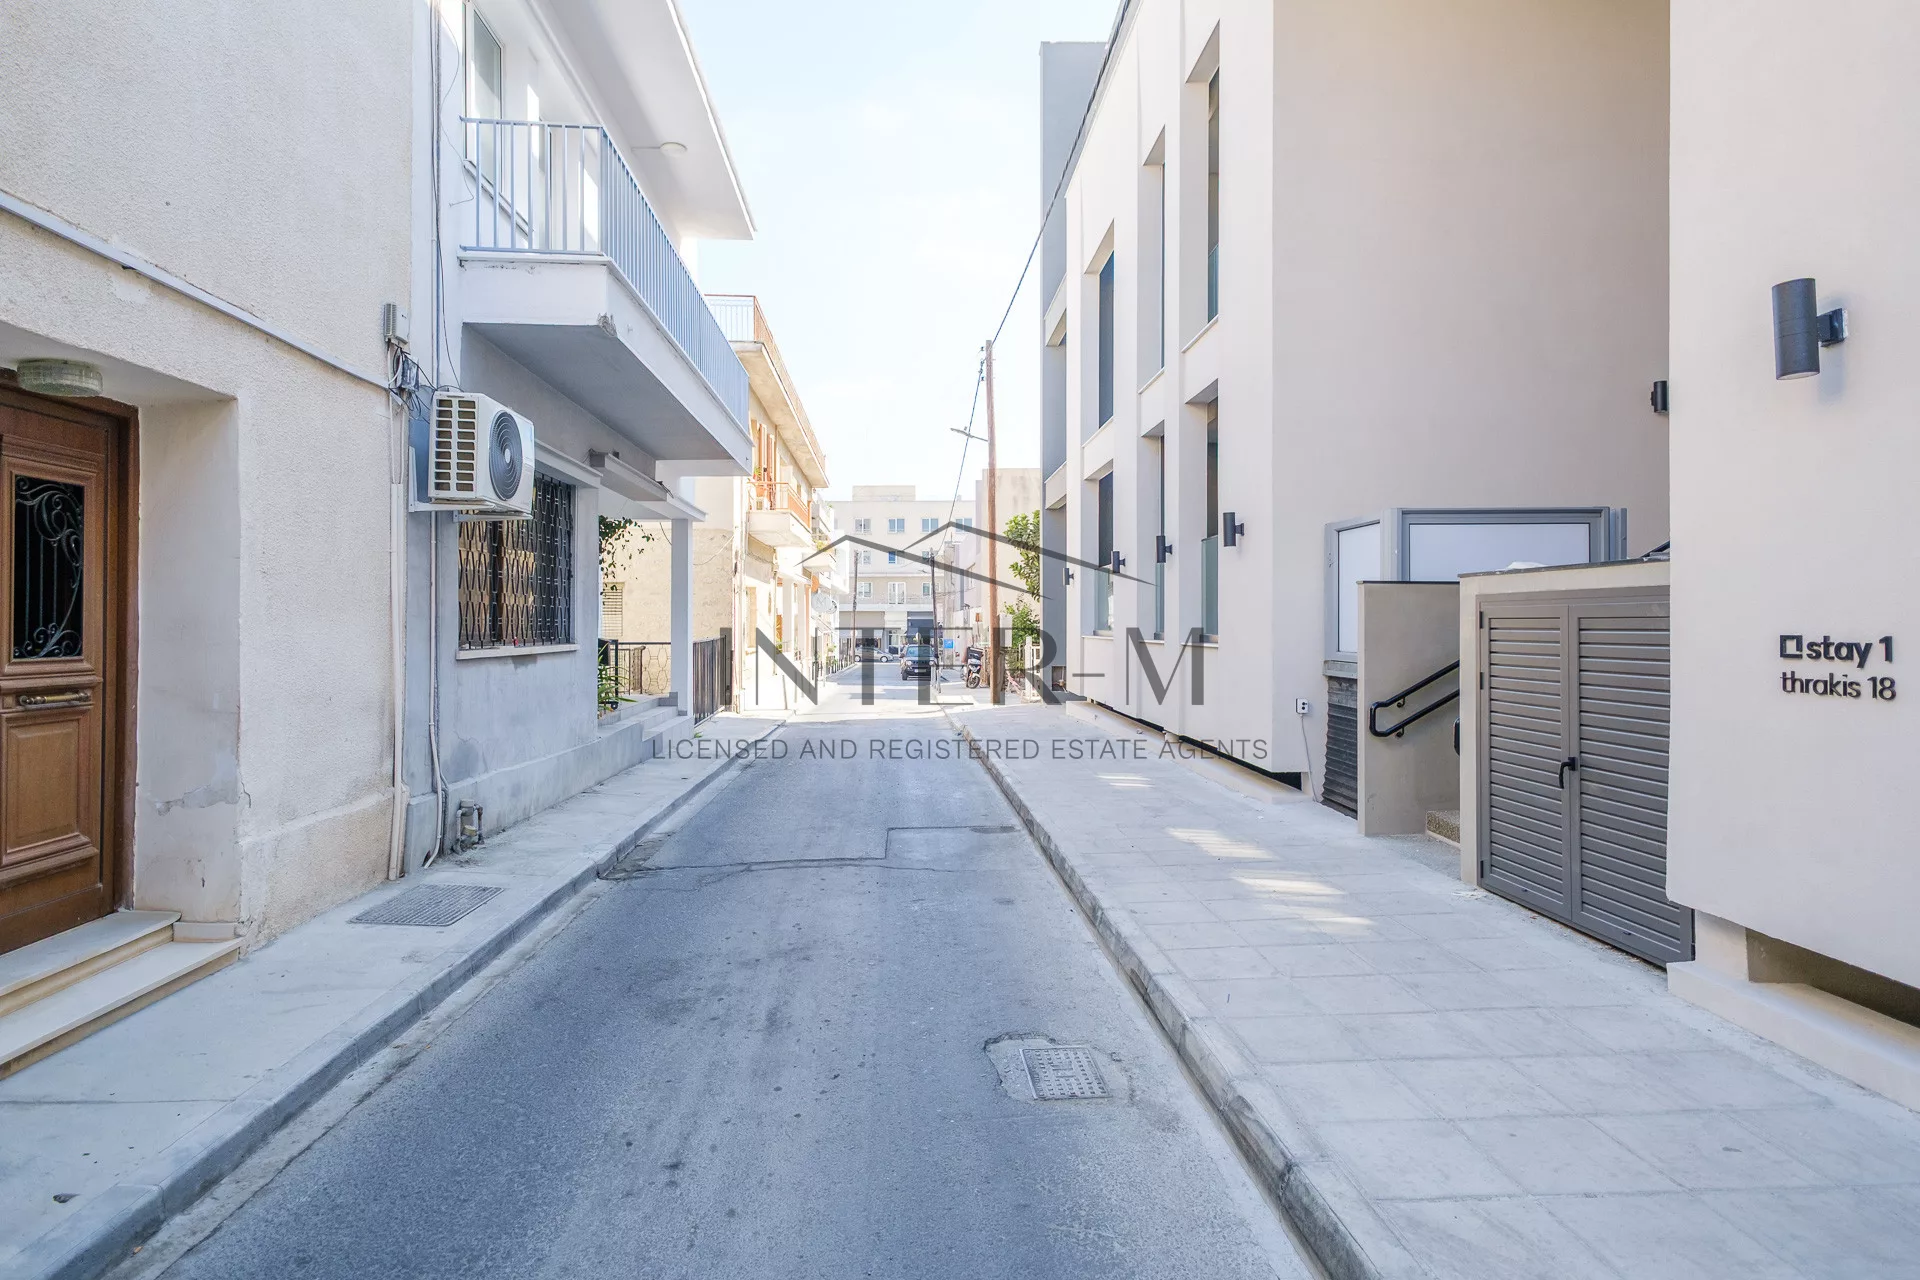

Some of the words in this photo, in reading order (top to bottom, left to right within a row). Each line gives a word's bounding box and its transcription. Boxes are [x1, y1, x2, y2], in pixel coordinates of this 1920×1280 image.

[1806, 635, 1873, 669] stay
[1879, 635, 1893, 663] 1
[1780, 670, 1861, 698] thrakis
[1867, 676, 1896, 701] 18
